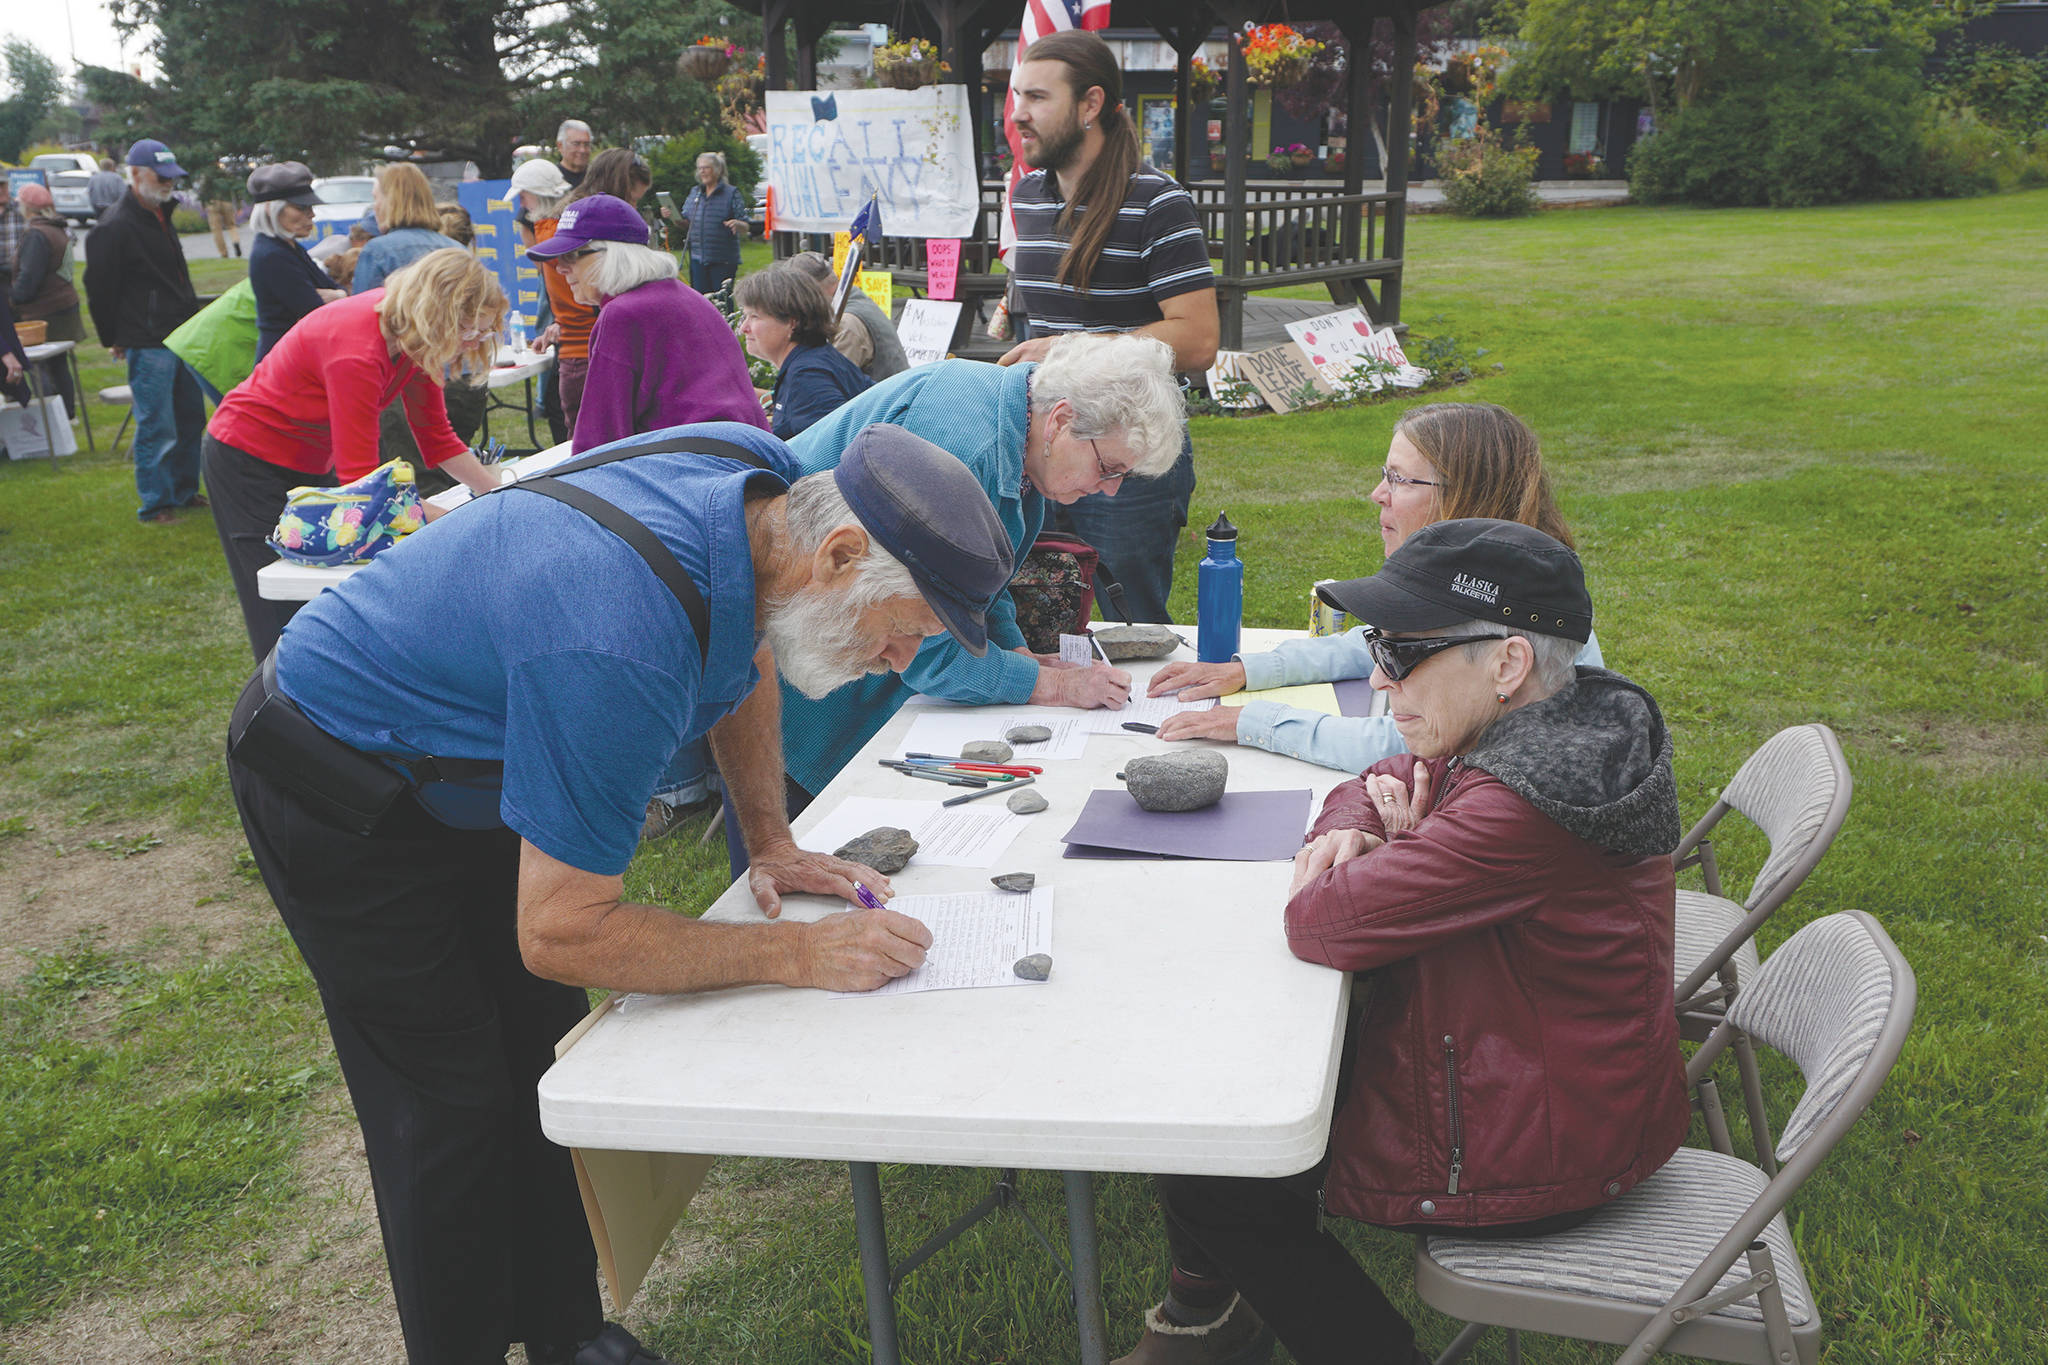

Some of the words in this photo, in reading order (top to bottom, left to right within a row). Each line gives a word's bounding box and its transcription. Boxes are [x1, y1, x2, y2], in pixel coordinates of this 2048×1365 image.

[771, 120, 923, 165] RECALL
[865, 277, 889, 293] SAVE
[1310, 316, 1343, 331] DON'T
[1331, 338, 1357, 353] CUT
[1247, 346, 1299, 374] DONE.
[1257, 363, 1317, 393] LEAVE.
[1450, 583, 1496, 605] TALKEETNA
[1453, 572, 1500, 595] ALASKA
